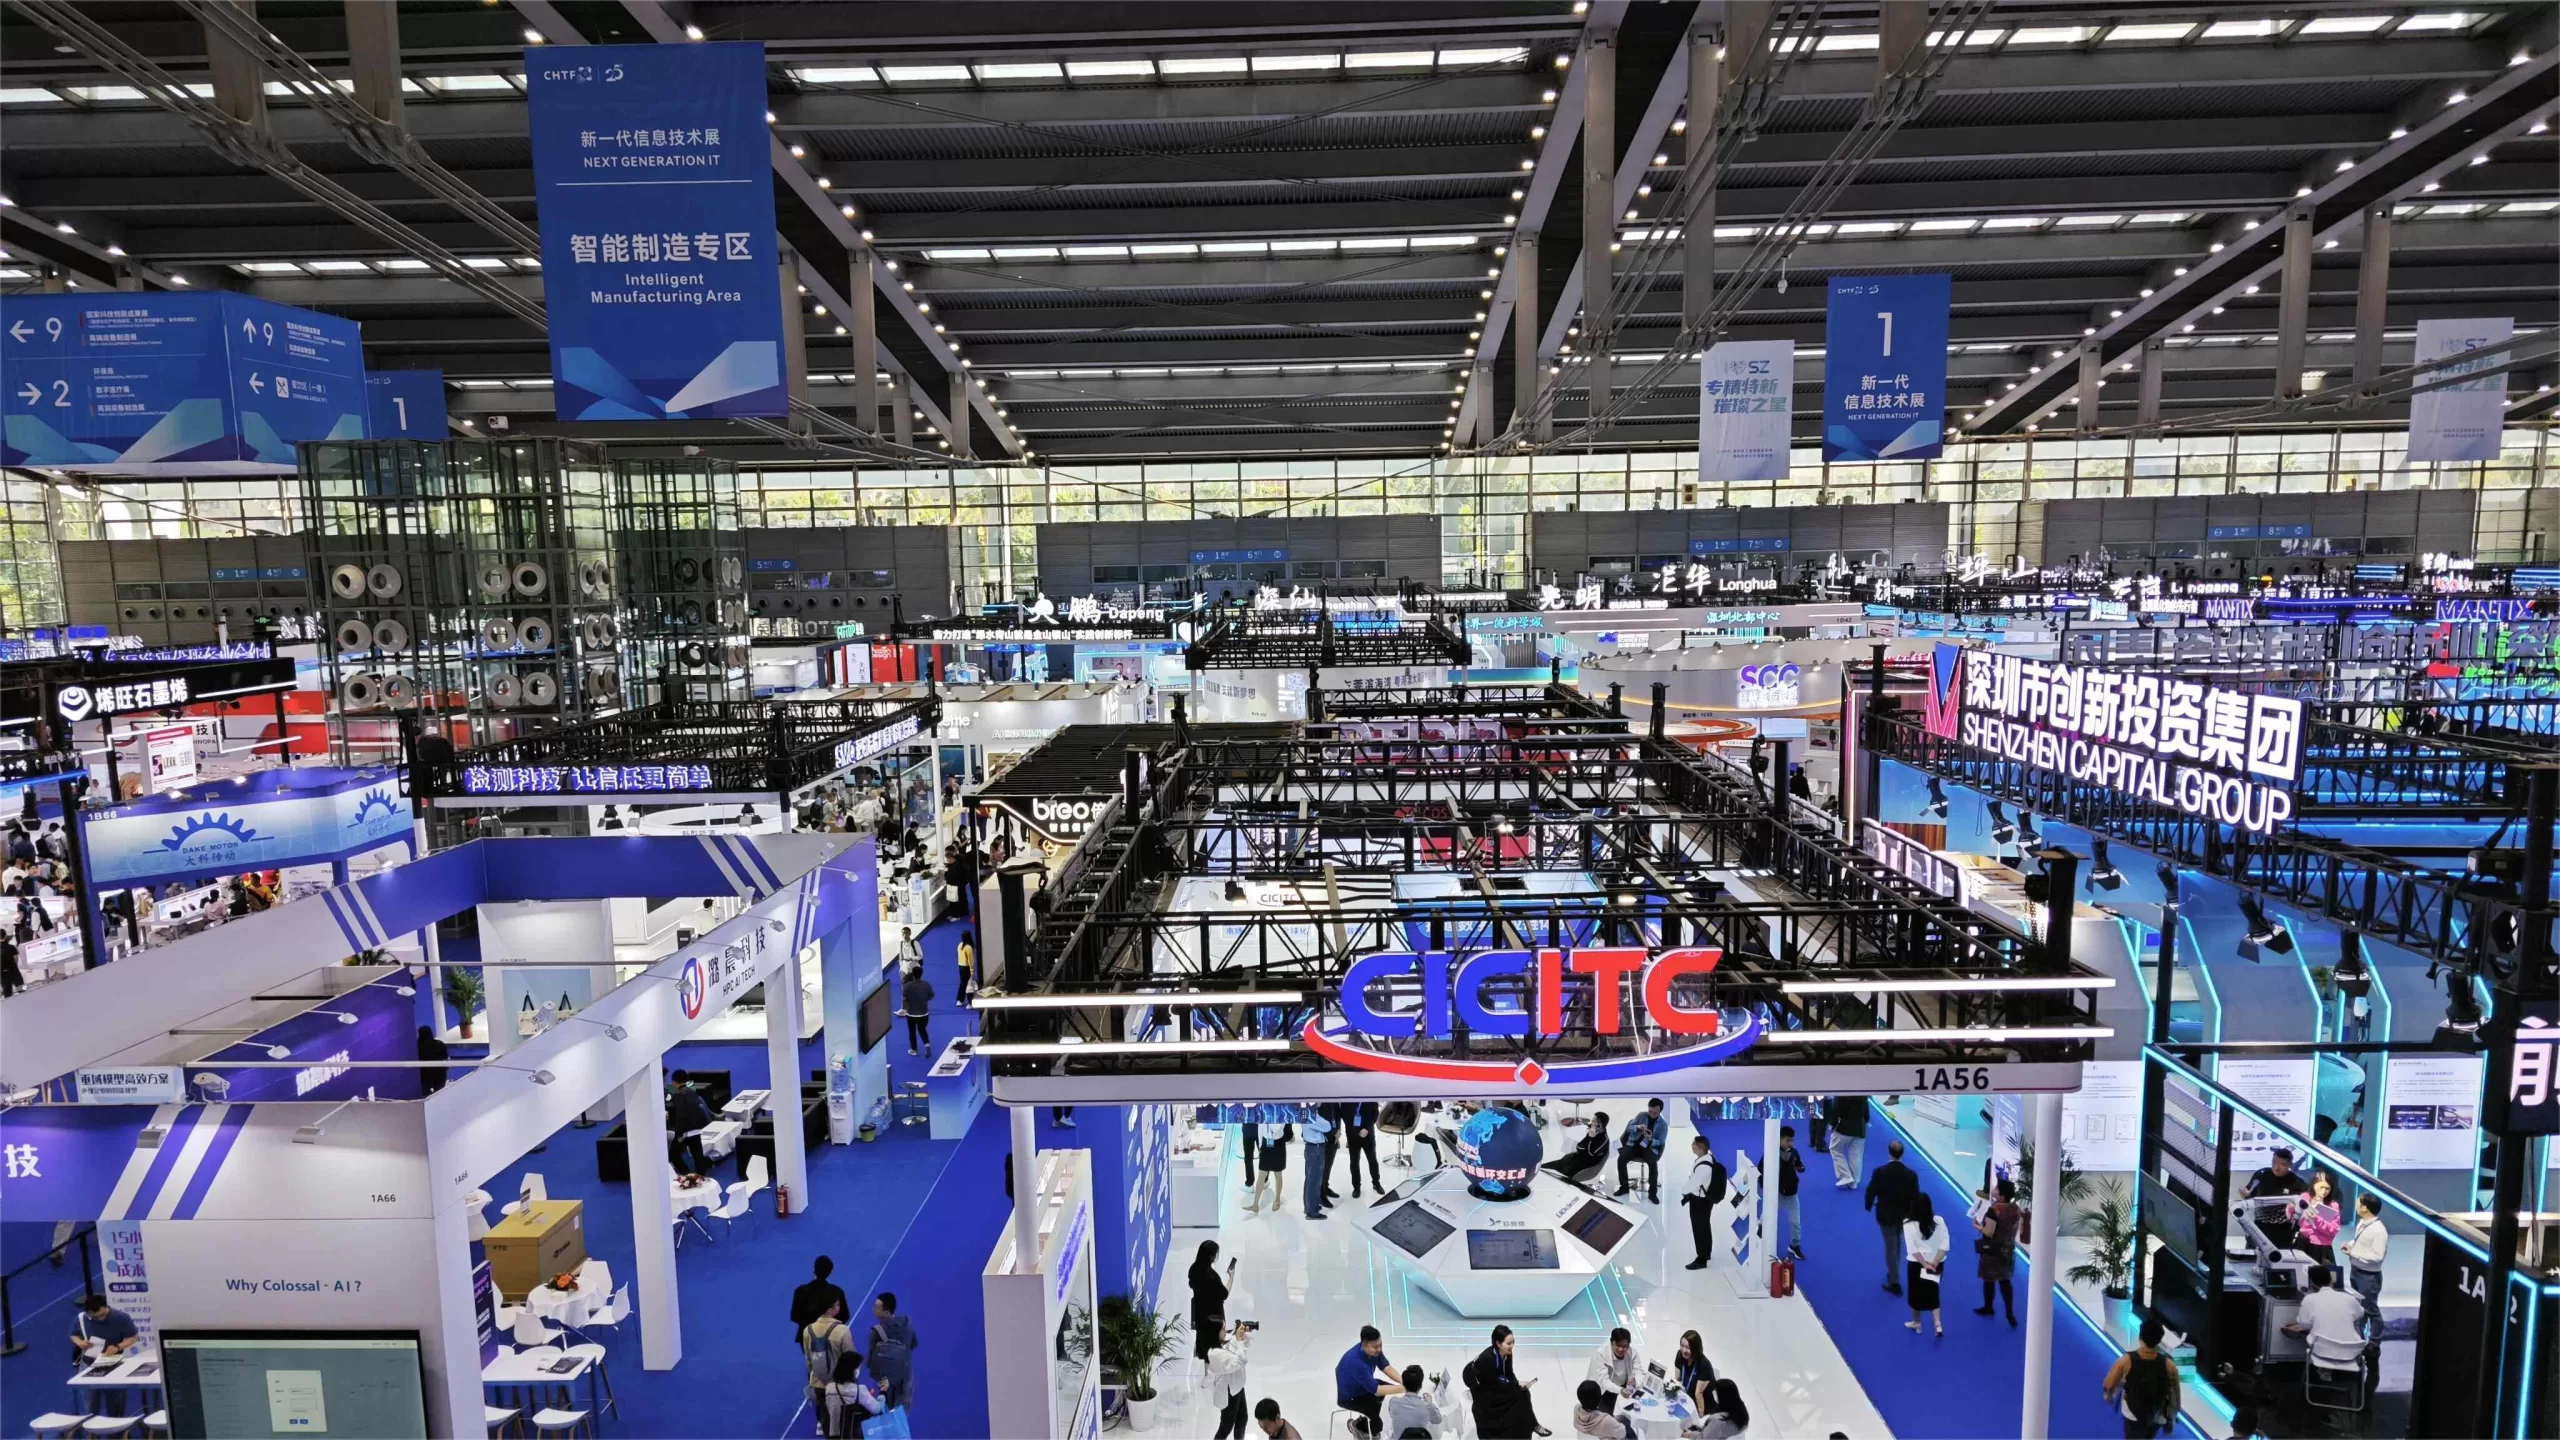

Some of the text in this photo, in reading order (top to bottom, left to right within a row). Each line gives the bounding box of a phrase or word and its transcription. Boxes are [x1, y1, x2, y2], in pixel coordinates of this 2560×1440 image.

[544, 70, 576, 81] CHTF
[580, 129, 721, 148] 新一代信息技术展
[584, 155, 720, 168] NEXT GENERATION IT
[570, 232, 752, 264] 智能制造专区
[625, 273, 704, 287] Intelligent
[591, 290, 741, 304] Manufacturing Area
[46, 317, 62, 342] 9
[263, 322, 273, 346] 9
[1877, 312, 1893, 356] 1
[1748, 360, 1770, 374] SZ
[1705, 378, 1779, 396] 专精特新
[1861, 374, 1910, 390] 新一代
[52, 379, 72, 407] 2
[1844, 392, 1925, 410] 信息技术展
[393, 398, 407, 430] 1
[1848, 413, 1865, 421] NEXT
[1867, 412, 1910, 420] GENERATION
[1247, 551, 1253, 559] 6
[757, 560, 763, 569] 5
[1958, 553, 2038, 587] 坪山
[1719, 578, 1777, 593] Longhua
[2171, 582, 2239, 594] Lnggang
[1539, 584, 1602, 611] 光明
[1028, 592, 1164, 625] 大鹏 Dapeng
[1740, 663, 1800, 689] SCC
[95, 678, 187, 713] 烯旺石墨烯
[1966, 651, 2302, 781] 深圳市创新投资集团
[468, 765, 712, 792] 检测科技 让信任更简单
[1963, 712, 2291, 835] SHENZHEN CAPITAL GROUP
[88, 810, 117, 821] 1B66
[1033, 798, 1089, 820] breo
[182, 841, 239, 854] DAKE MOTOR
[185, 851, 236, 866] 大科传动
[723, 965, 756, 997] HPC AI TECH
[1341, 948, 1723, 1035] CICITC
[1914, 1067, 1990, 1091] 1A56
[454, 1170, 470, 1187] 1A66
[370, 1192, 396, 1204] 1A66
[226, 1278, 258, 1295] Why
[263, 1278, 320, 1292] Colossal
[334, 1280, 351, 1293] AI
[355, 1280, 361, 1293] ?
